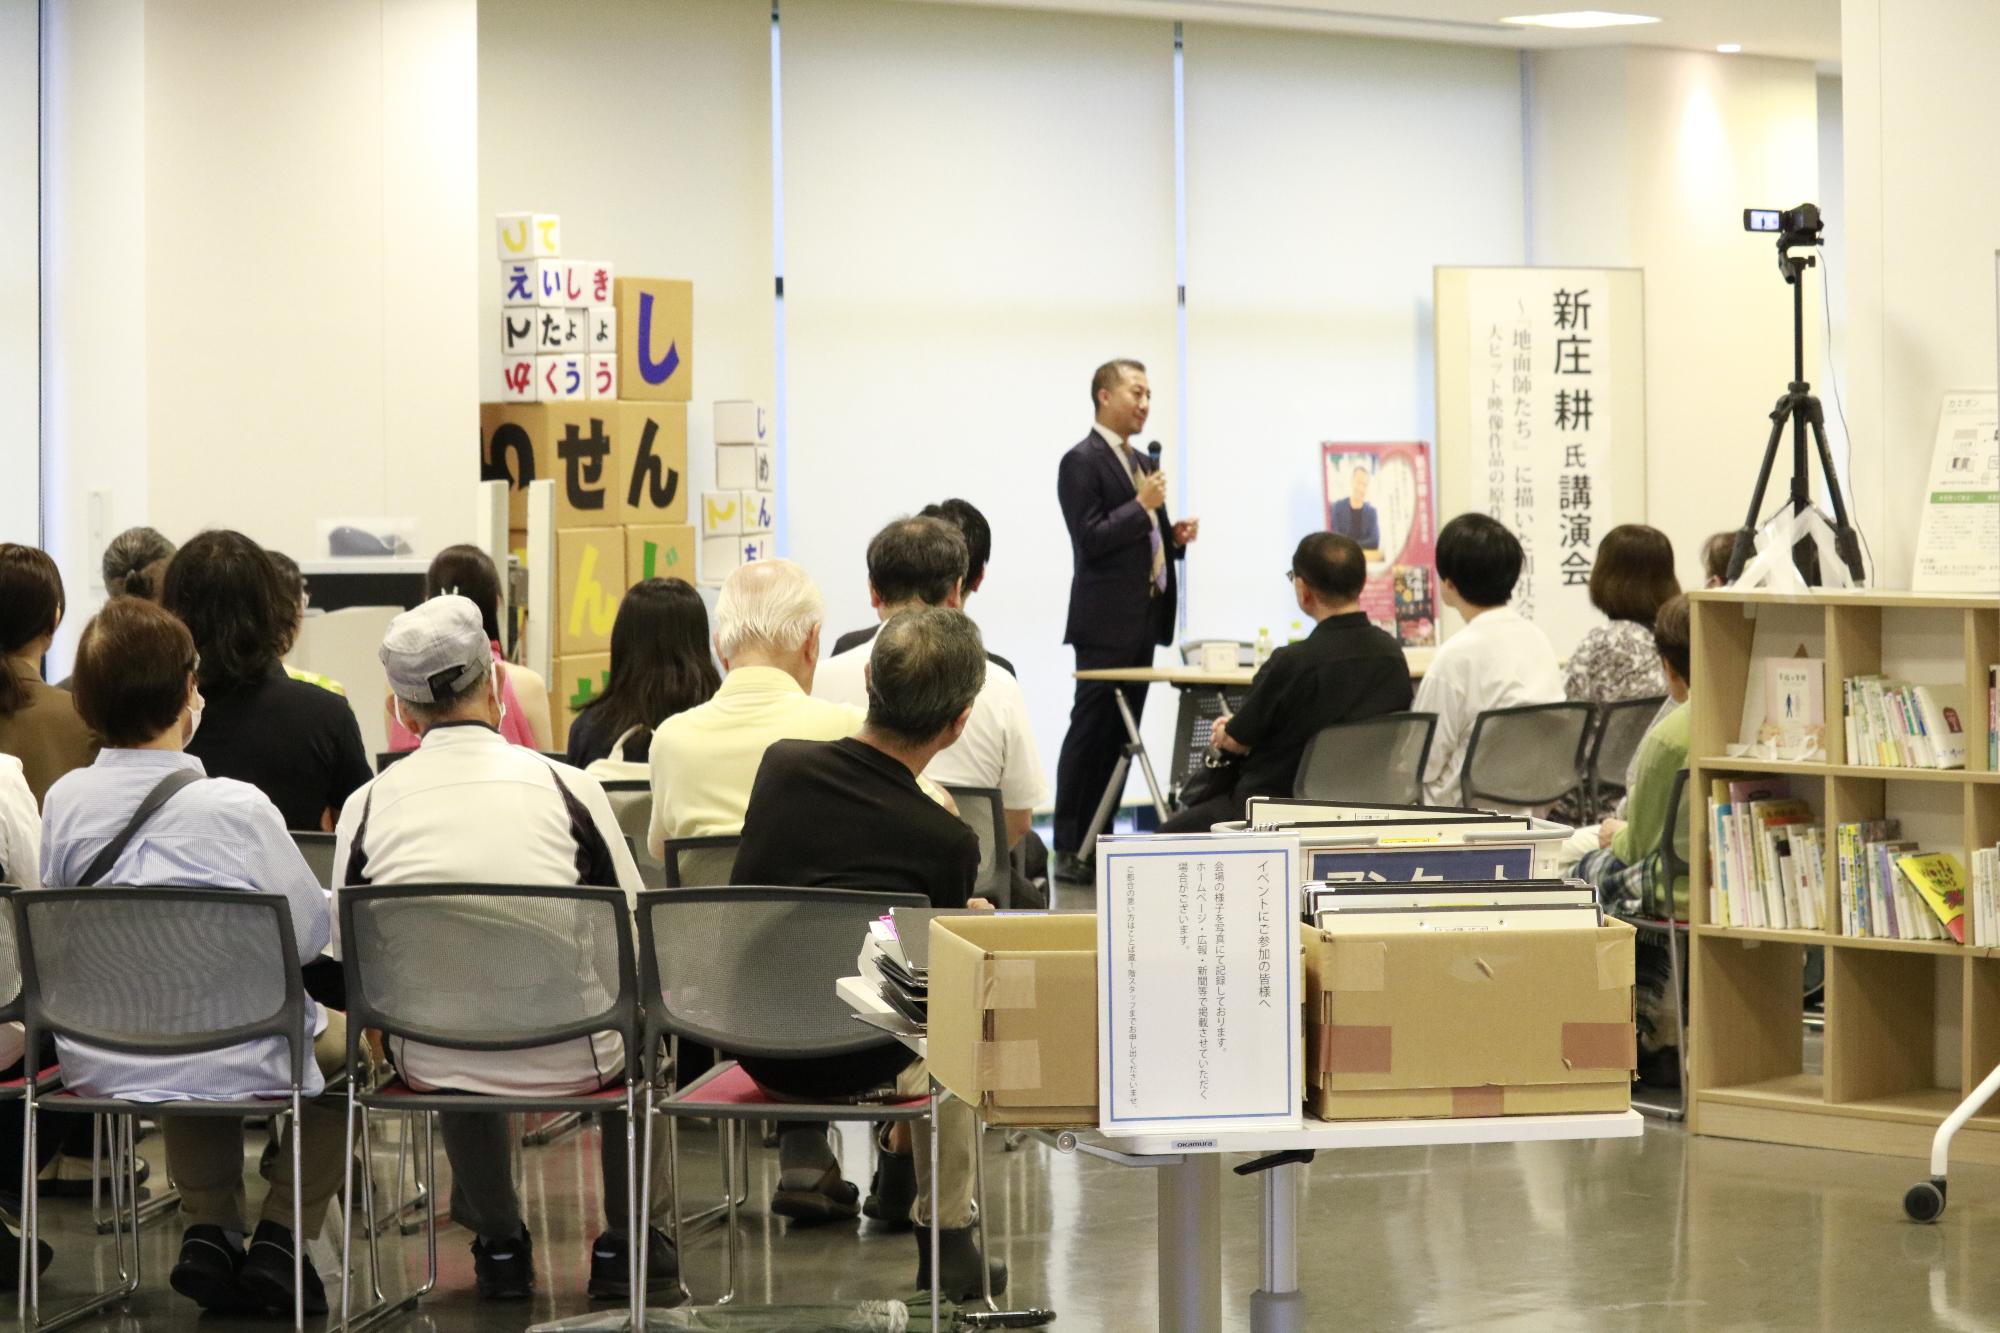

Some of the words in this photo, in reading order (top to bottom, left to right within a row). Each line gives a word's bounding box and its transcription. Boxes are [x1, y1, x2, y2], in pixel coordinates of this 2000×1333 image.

[1177, 862, 1190, 951] 場合がございます。
[1214, 860, 1227, 1052] 会場の様子を写真にて記録しております。
[1257, 860, 1271, 1009] イベントにご参加の皆様へ
[1176, 1140, 1213, 1148] okamura
